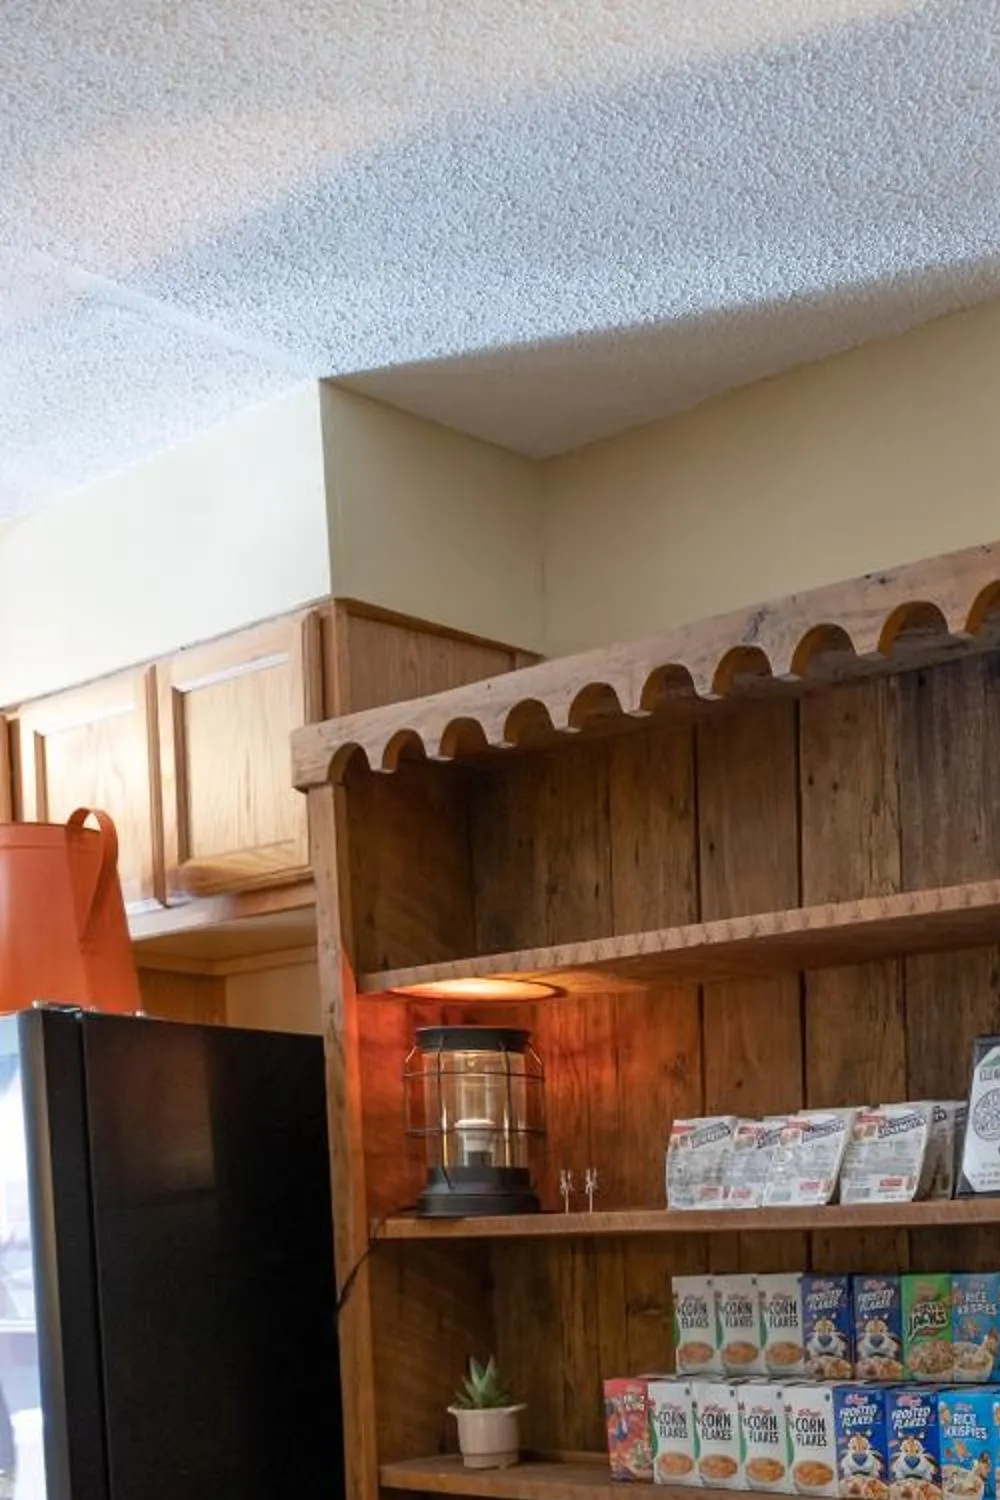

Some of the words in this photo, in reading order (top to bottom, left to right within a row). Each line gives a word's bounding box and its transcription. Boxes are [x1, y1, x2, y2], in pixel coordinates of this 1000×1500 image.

[965, 1291, 987, 1303] RICE
[681, 1301, 707, 1316] CORN
[725, 1301, 753, 1315] CORN
[769, 1300, 798, 1314] CORN
[659, 1410, 687, 1424] CORN
[701, 1412, 731, 1428] CORN
[891, 1406, 931, 1421] FROSTED
[953, 1413, 977, 1426] RICE
[748, 1415, 778, 1430] CORN
[795, 1417, 826, 1433] CORN
[659, 1425, 689, 1439] FLAKES
[702, 1428, 733, 1441] FLAKES
[749, 1431, 780, 1444] FLAKES
[796, 1433, 828, 1447] FLAKES
